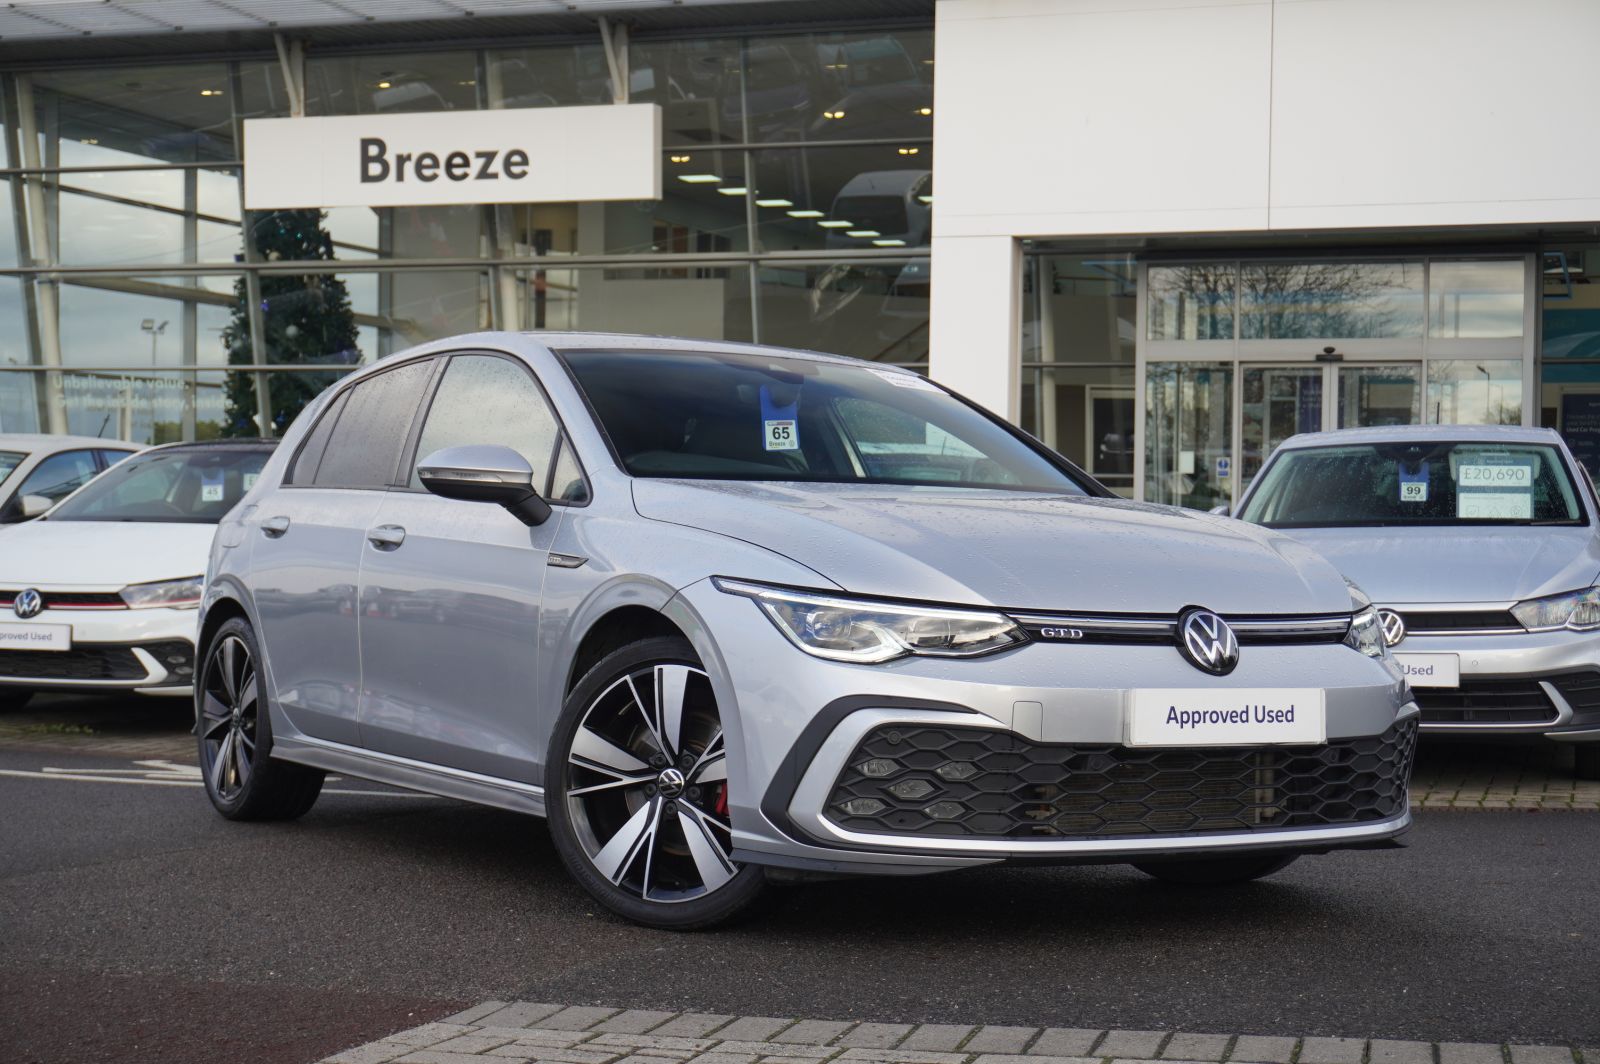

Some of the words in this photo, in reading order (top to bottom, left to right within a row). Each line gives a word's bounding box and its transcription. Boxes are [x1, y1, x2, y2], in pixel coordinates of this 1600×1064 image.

[360, 137, 529, 183] Breeze
[52, 375, 145, 390] Unbelievable
[54, 394, 79, 408] Get
[83, 394, 105, 408] the
[107, 394, 148, 409] inside
[772, 426, 790, 440] 65
[1464, 467, 1525, 481] £20,690
[206, 487, 218, 495] 45
[1406, 486, 1421, 495] 99
[31, 632, 53, 641] Used
[1040, 627, 1083, 639] GTD
[1402, 664, 1434, 676] Used
[1166, 705, 1249, 729] Approved
[1254, 704, 1294, 723] Used
